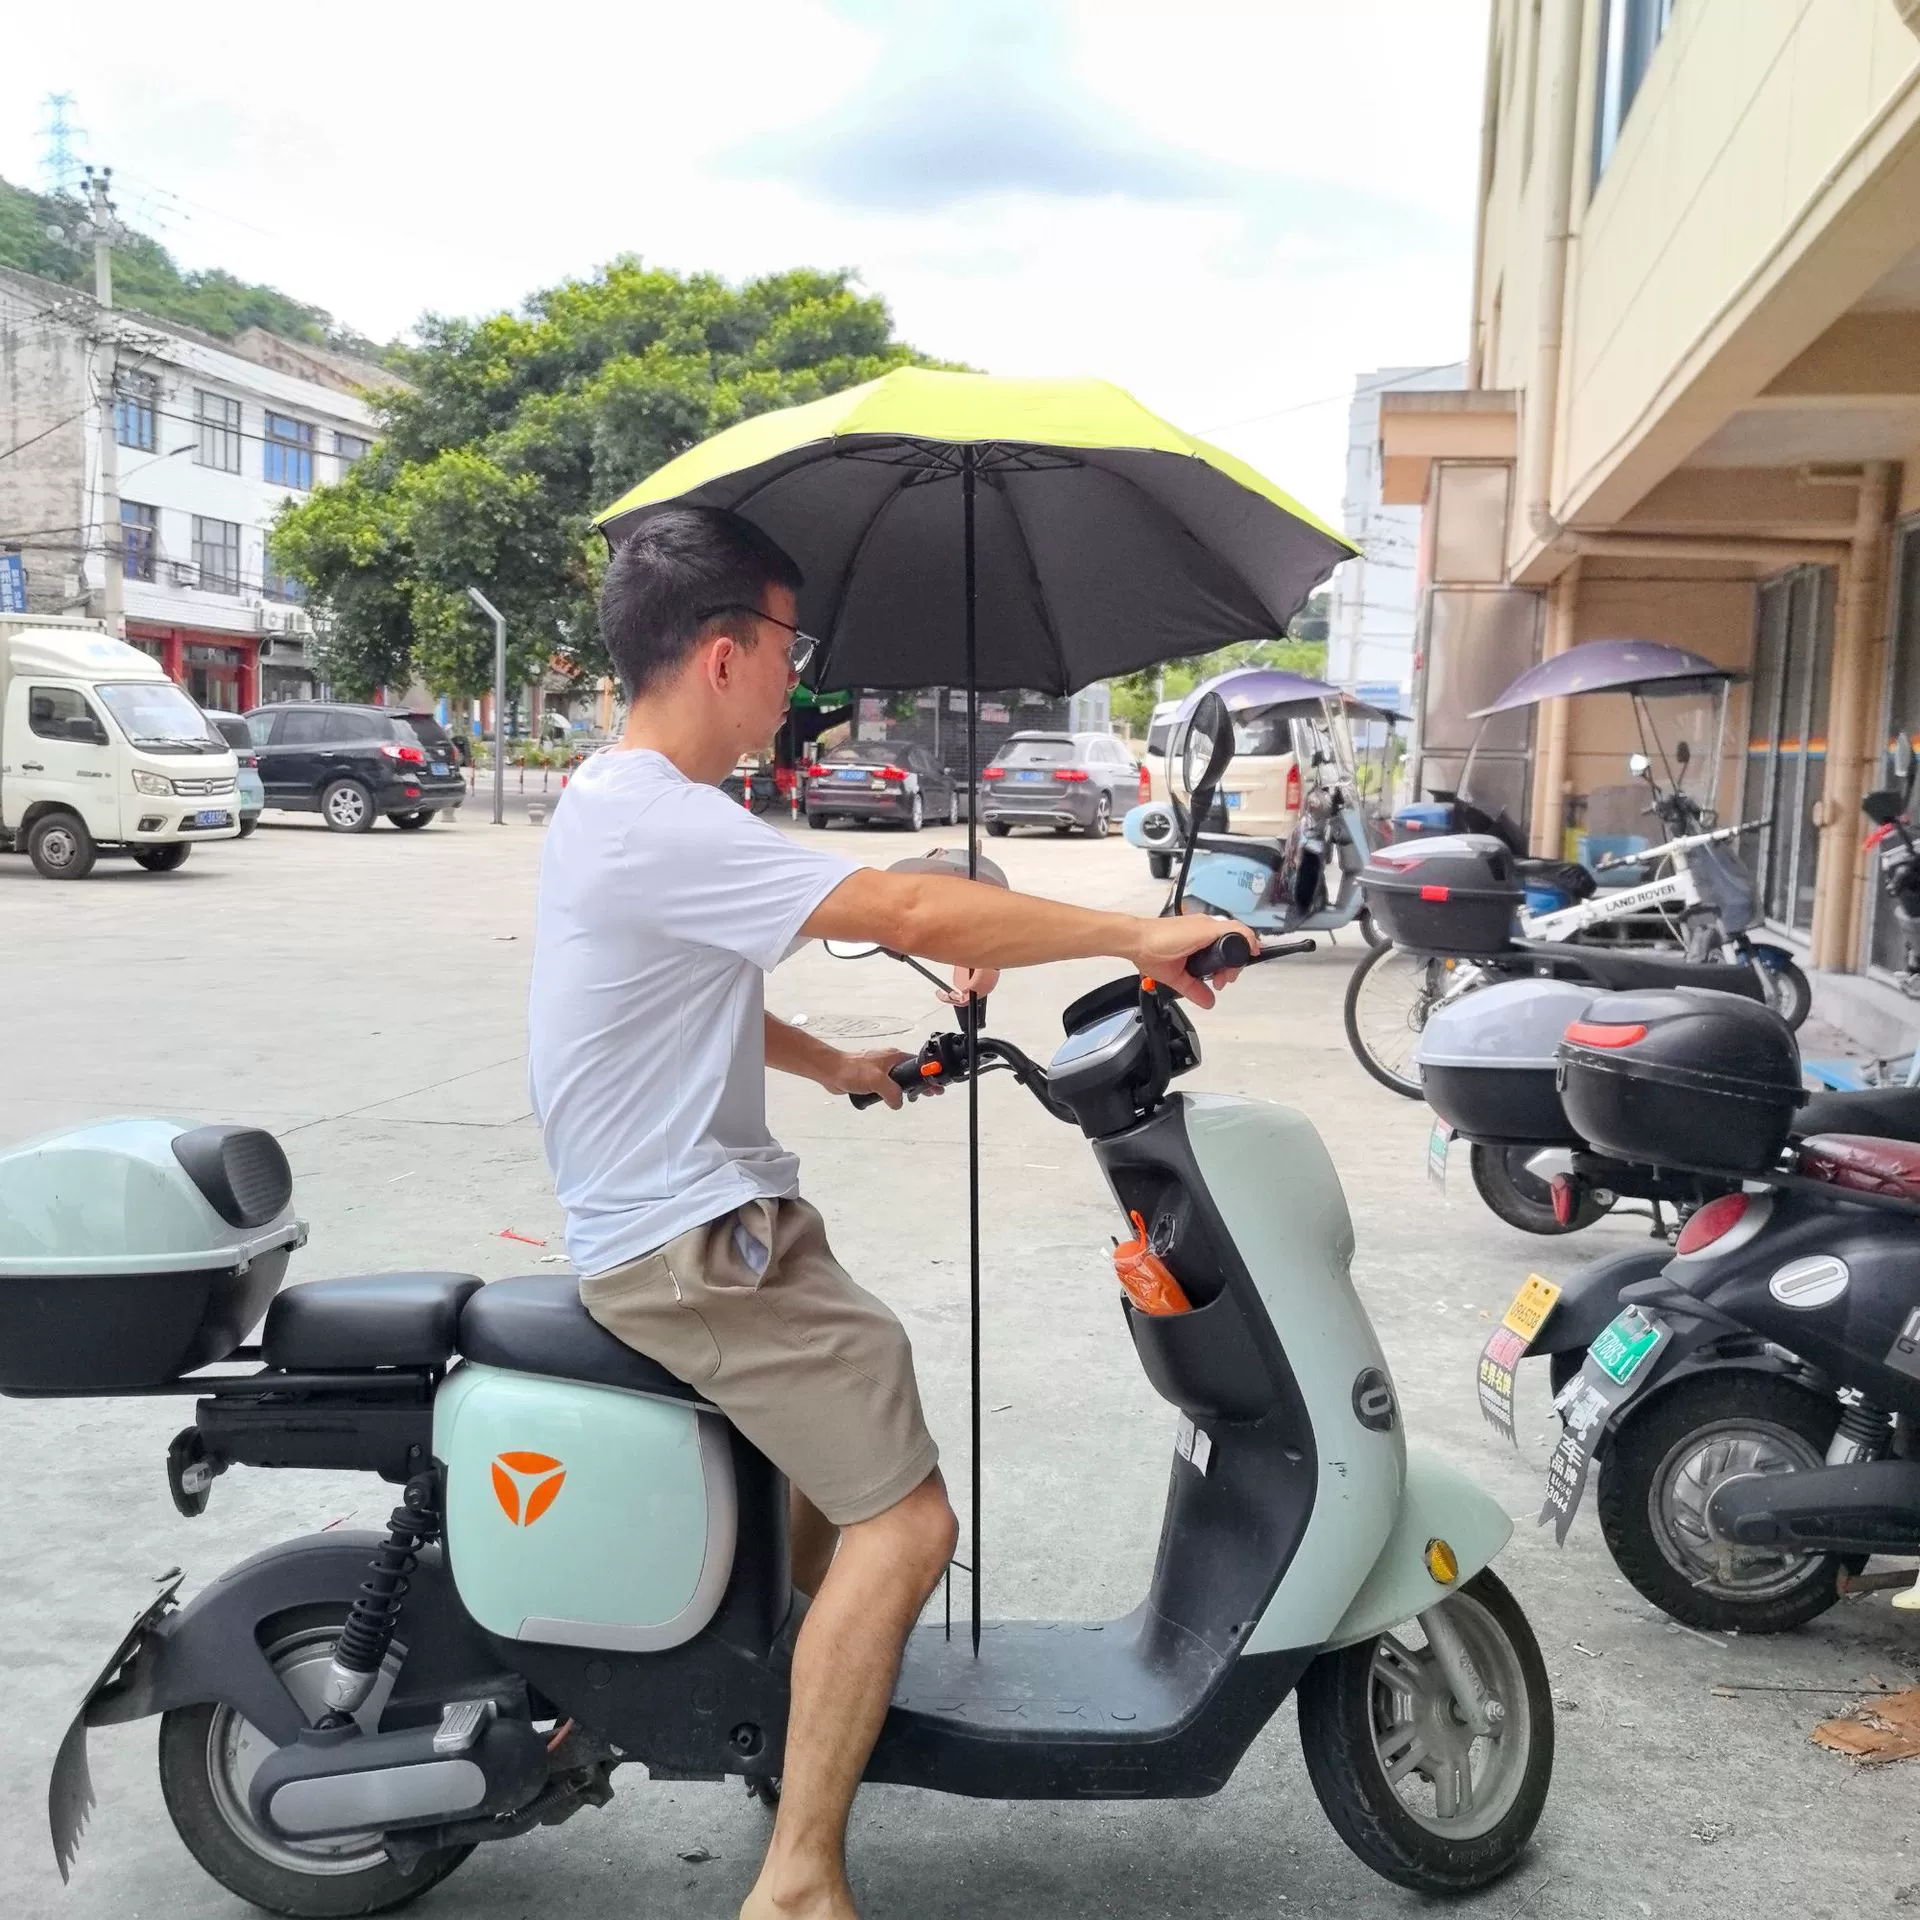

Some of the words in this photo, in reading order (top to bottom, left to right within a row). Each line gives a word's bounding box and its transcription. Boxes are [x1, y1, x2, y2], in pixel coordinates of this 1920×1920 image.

[1605, 896, 1636, 912] LAND
[1637, 884, 1676, 903] ROVER
[1559, 1433, 1585, 1467] 车
[1551, 1453, 1578, 1487] 品牌
